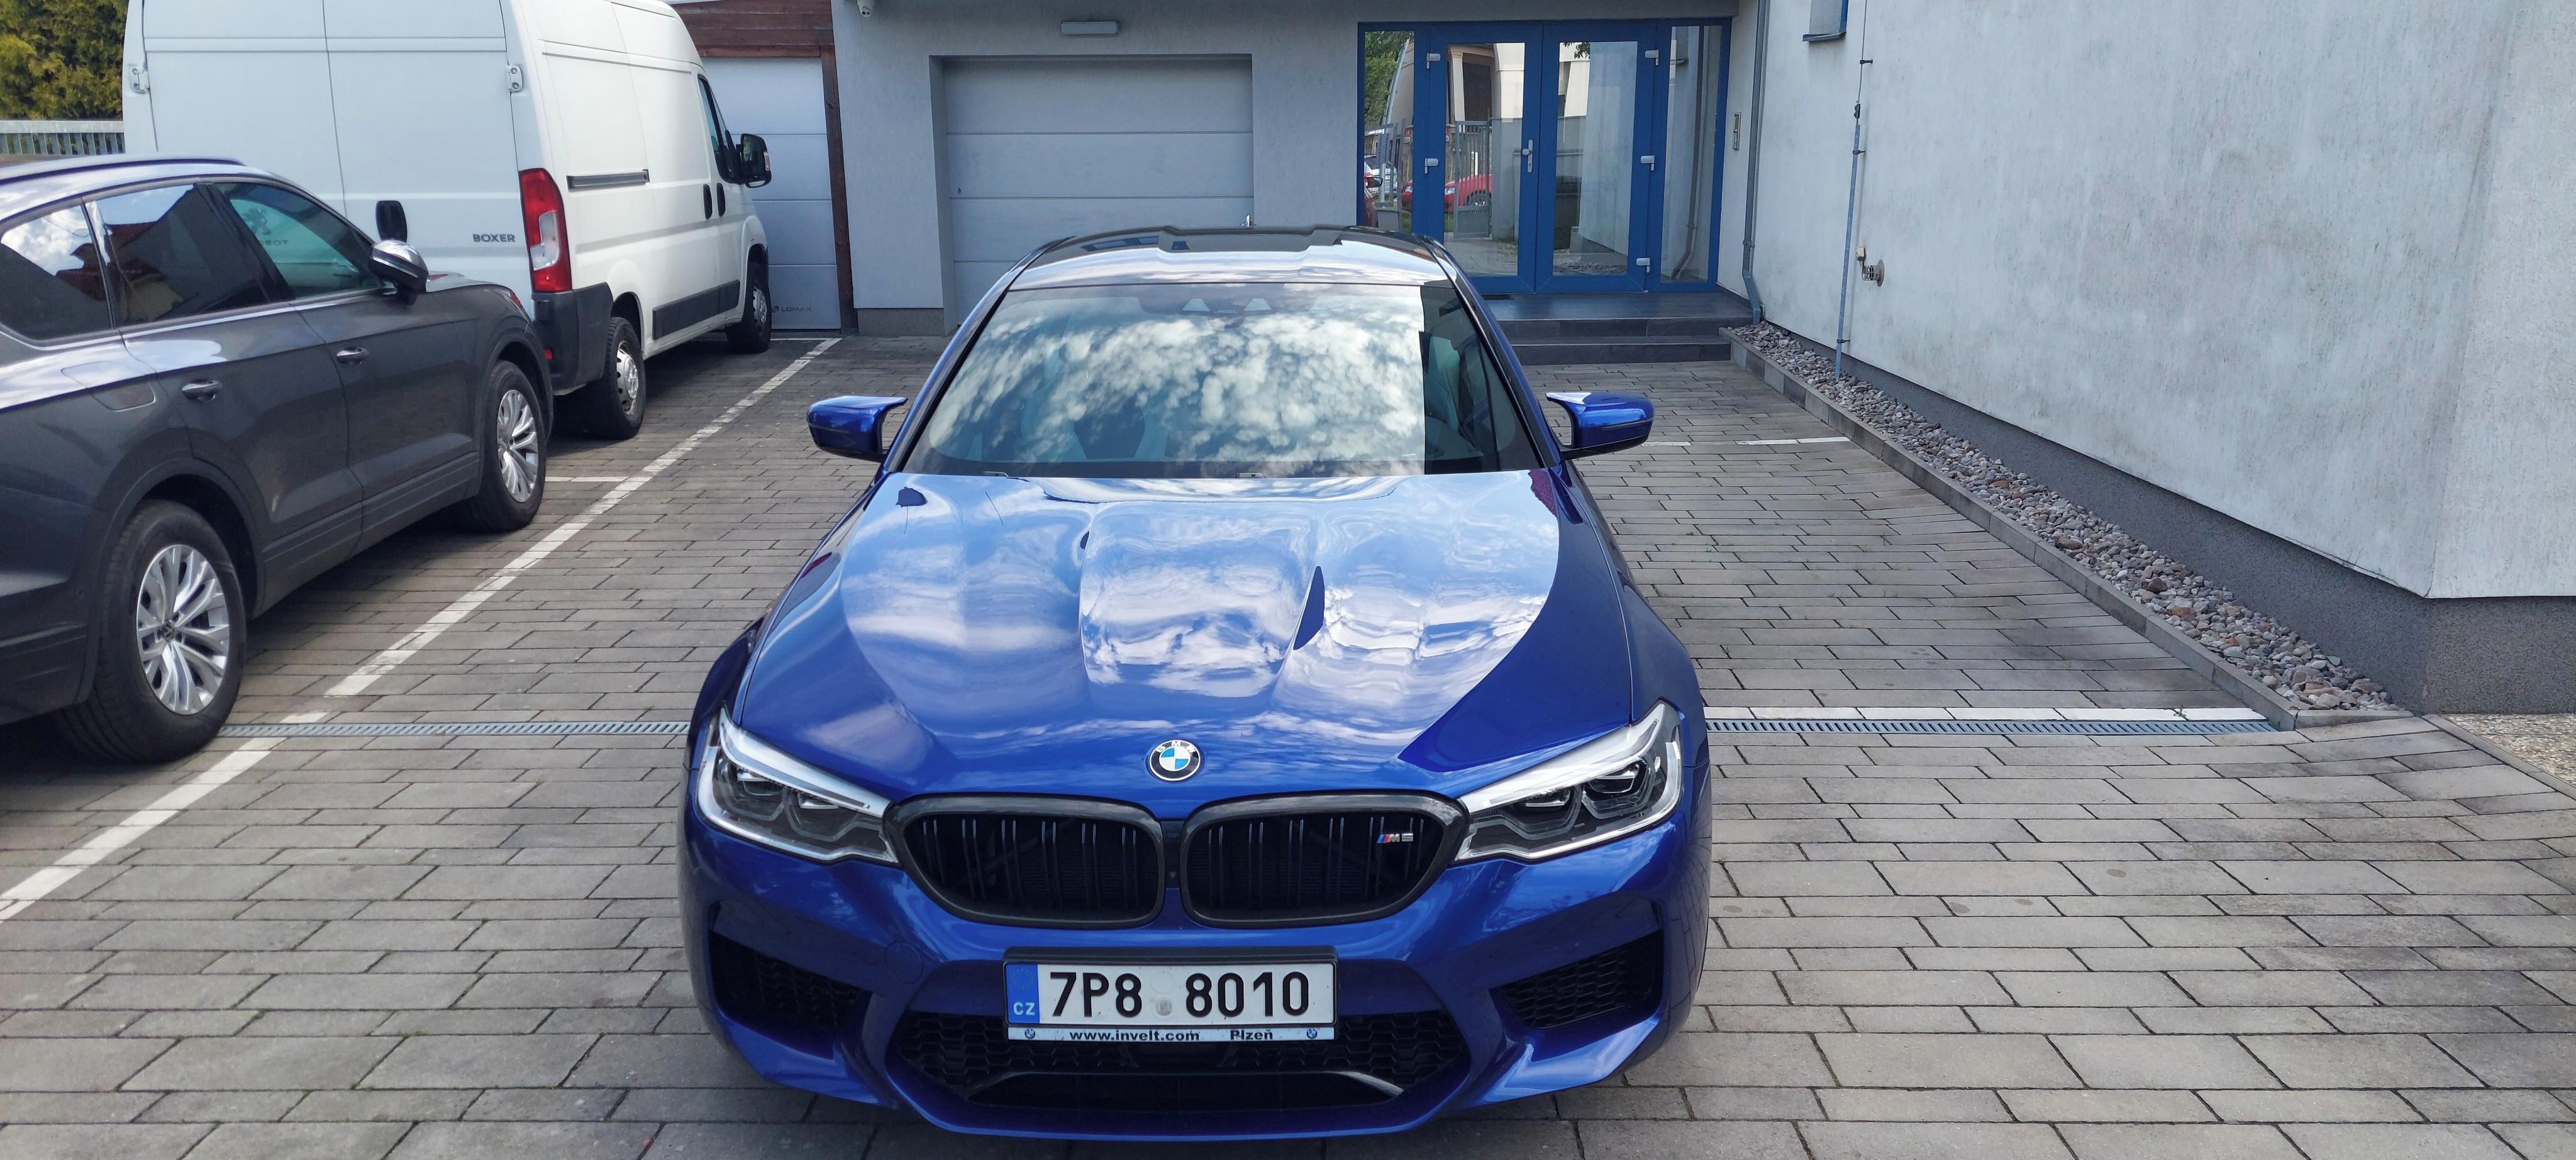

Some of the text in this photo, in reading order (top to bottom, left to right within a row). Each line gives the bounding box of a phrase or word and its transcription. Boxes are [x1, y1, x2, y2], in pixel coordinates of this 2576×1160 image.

[472, 233, 516, 242] BOXER
[1155, 740, 1196, 753] BMW
[1387, 833, 1414, 842] M5
[1050, 971, 1309, 1018] 7P8 8010
[1013, 1001, 1035, 1016] CZ
[1069, 1029, 1274, 1042] www.invelt.com Plzeň
